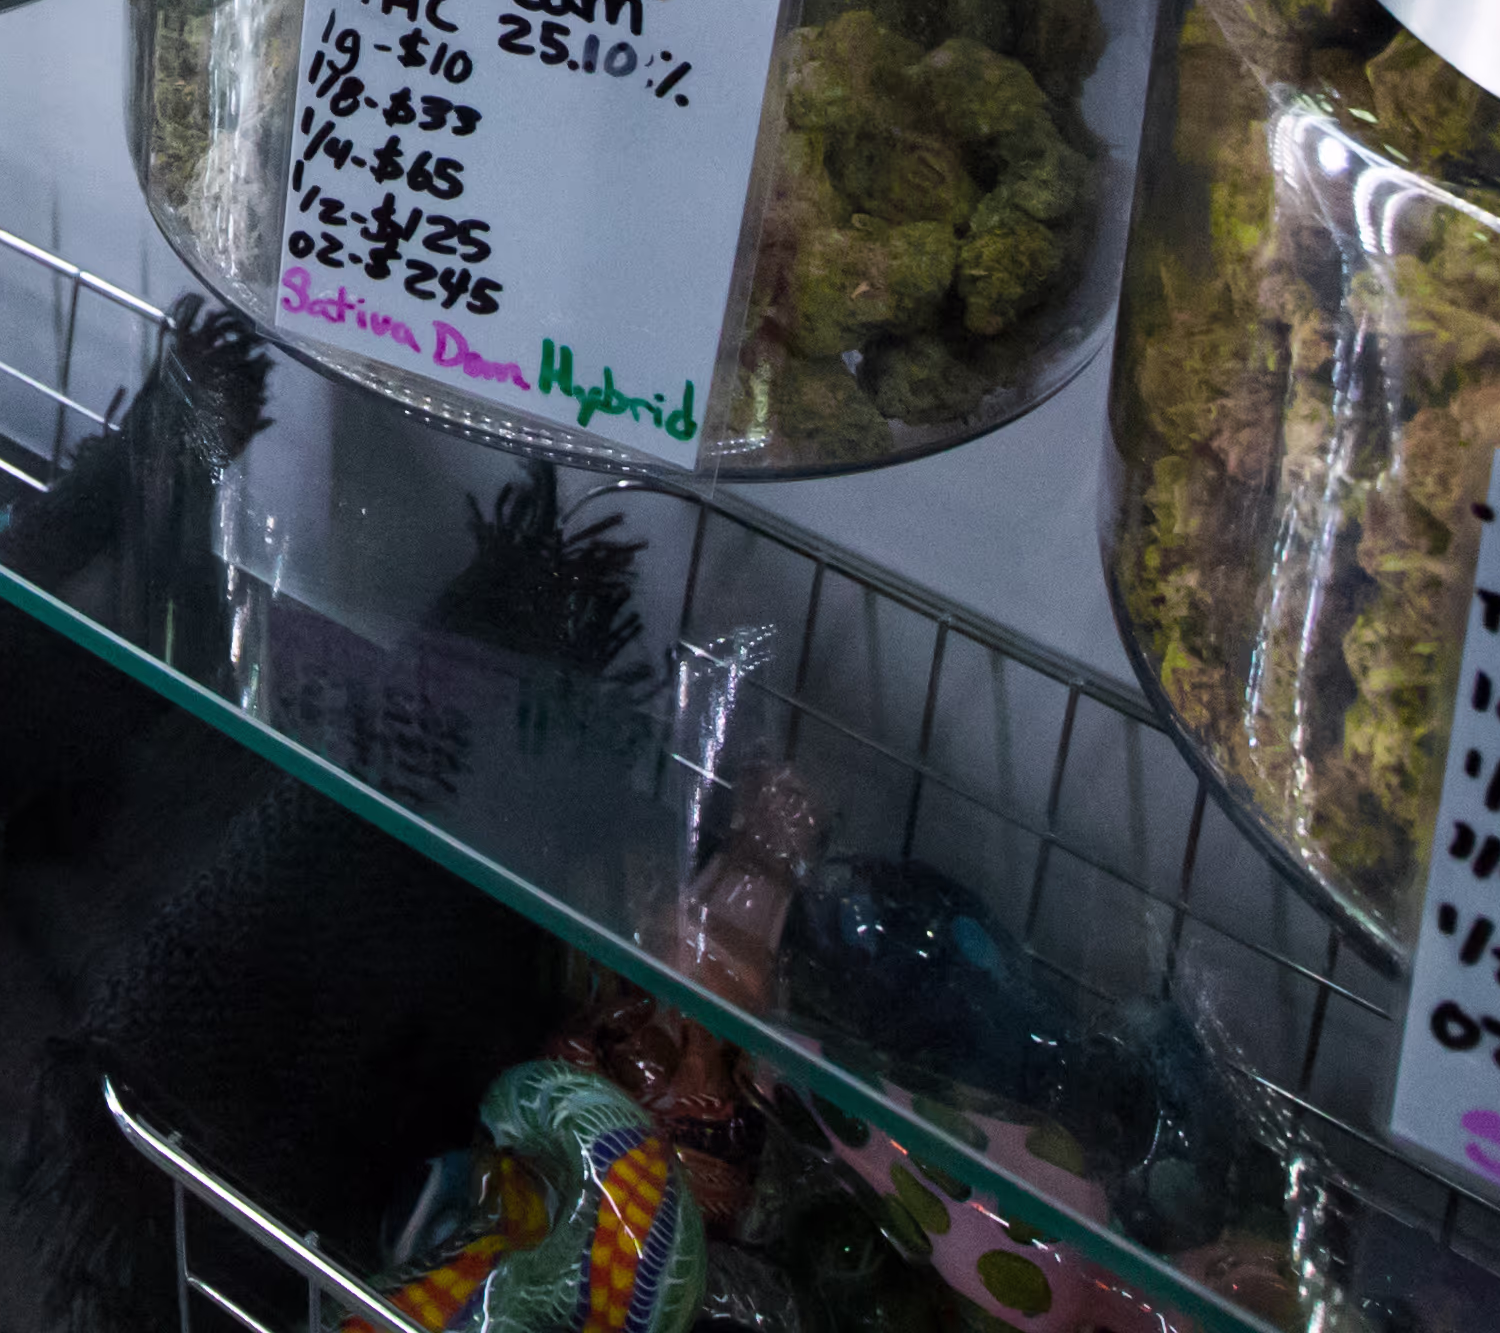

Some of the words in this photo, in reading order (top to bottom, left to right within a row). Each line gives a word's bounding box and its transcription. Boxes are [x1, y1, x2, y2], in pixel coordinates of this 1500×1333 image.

[281, 267, 421, 354] Sativa
[431, 319, 532, 391] Dom
[538, 338, 698, 440] Hybrid
